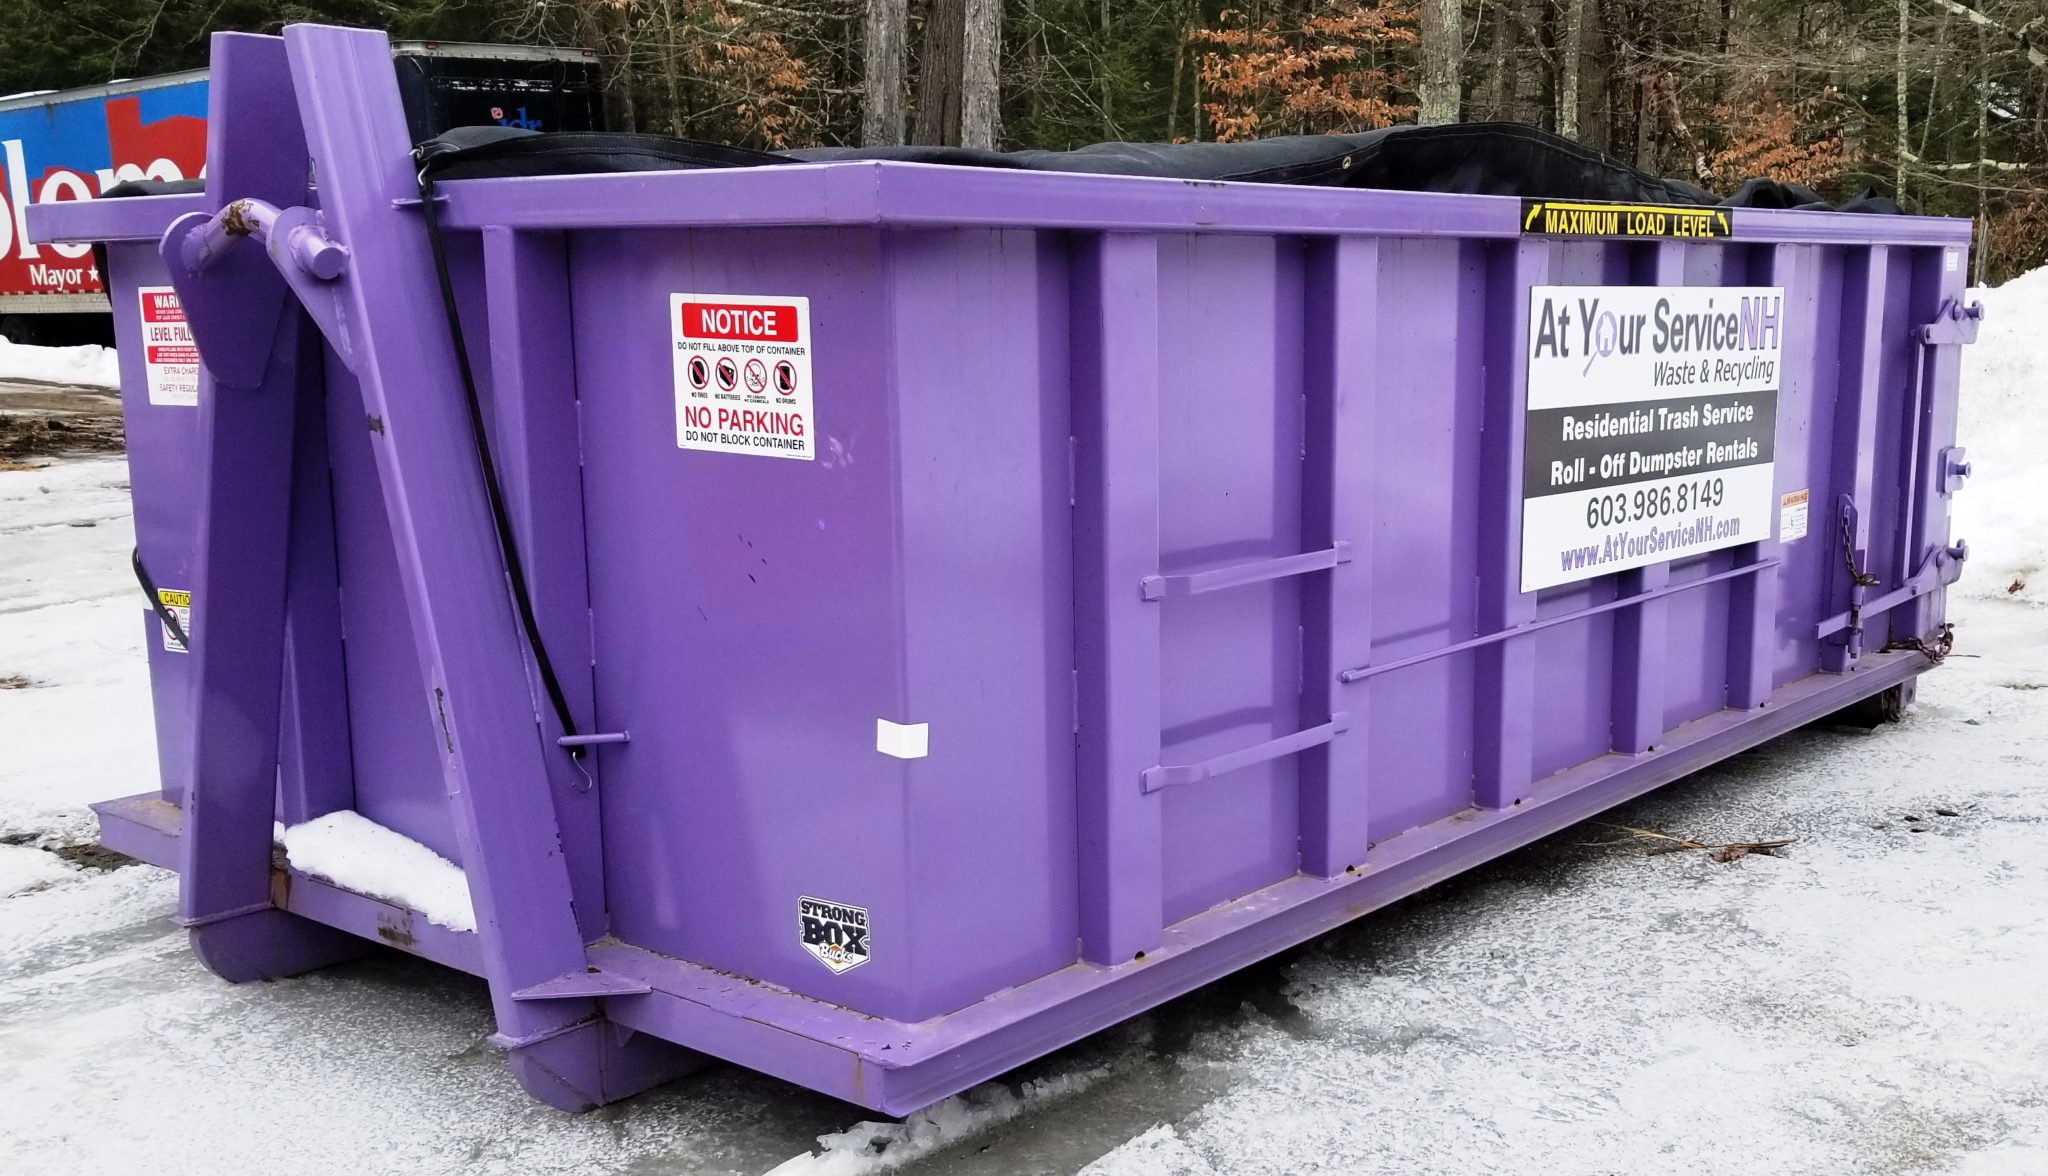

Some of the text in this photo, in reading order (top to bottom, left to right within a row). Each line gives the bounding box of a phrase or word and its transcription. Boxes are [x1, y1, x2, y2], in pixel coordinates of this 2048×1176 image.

[1545, 210, 1714, 237] MAXIMUM LOAD LEVEL
[29, 263, 83, 291] Mayor
[151, 326, 172, 341] LEVEL
[702, 308, 777, 336] NOTICE
[1534, 298, 1571, 358] At
[678, 341, 805, 356] DO NOT FILL ABOVE TOP OF CONTAINER
[1653, 356, 1774, 387] Waste & Recycling
[685, 405, 804, 437] NO PARKING
[1562, 401, 1753, 441] Residential Trash Service
[686, 430, 805, 451] DO NOT BLOCK CONTAINER
[1550, 458, 1585, 486] Roll
[1600, 452, 1626, 479] Off
[1629, 446, 1703, 475] Dumpster
[1706, 437, 1758, 465] Rentals
[1586, 477, 1724, 530] 603.986.8149
[1561, 515, 1741, 572] www.AtYourServiceNH.com
[164, 592, 190, 606] CAUTIO
[801, 900, 867, 927] STRONG
[802, 915, 867, 957] BOX
